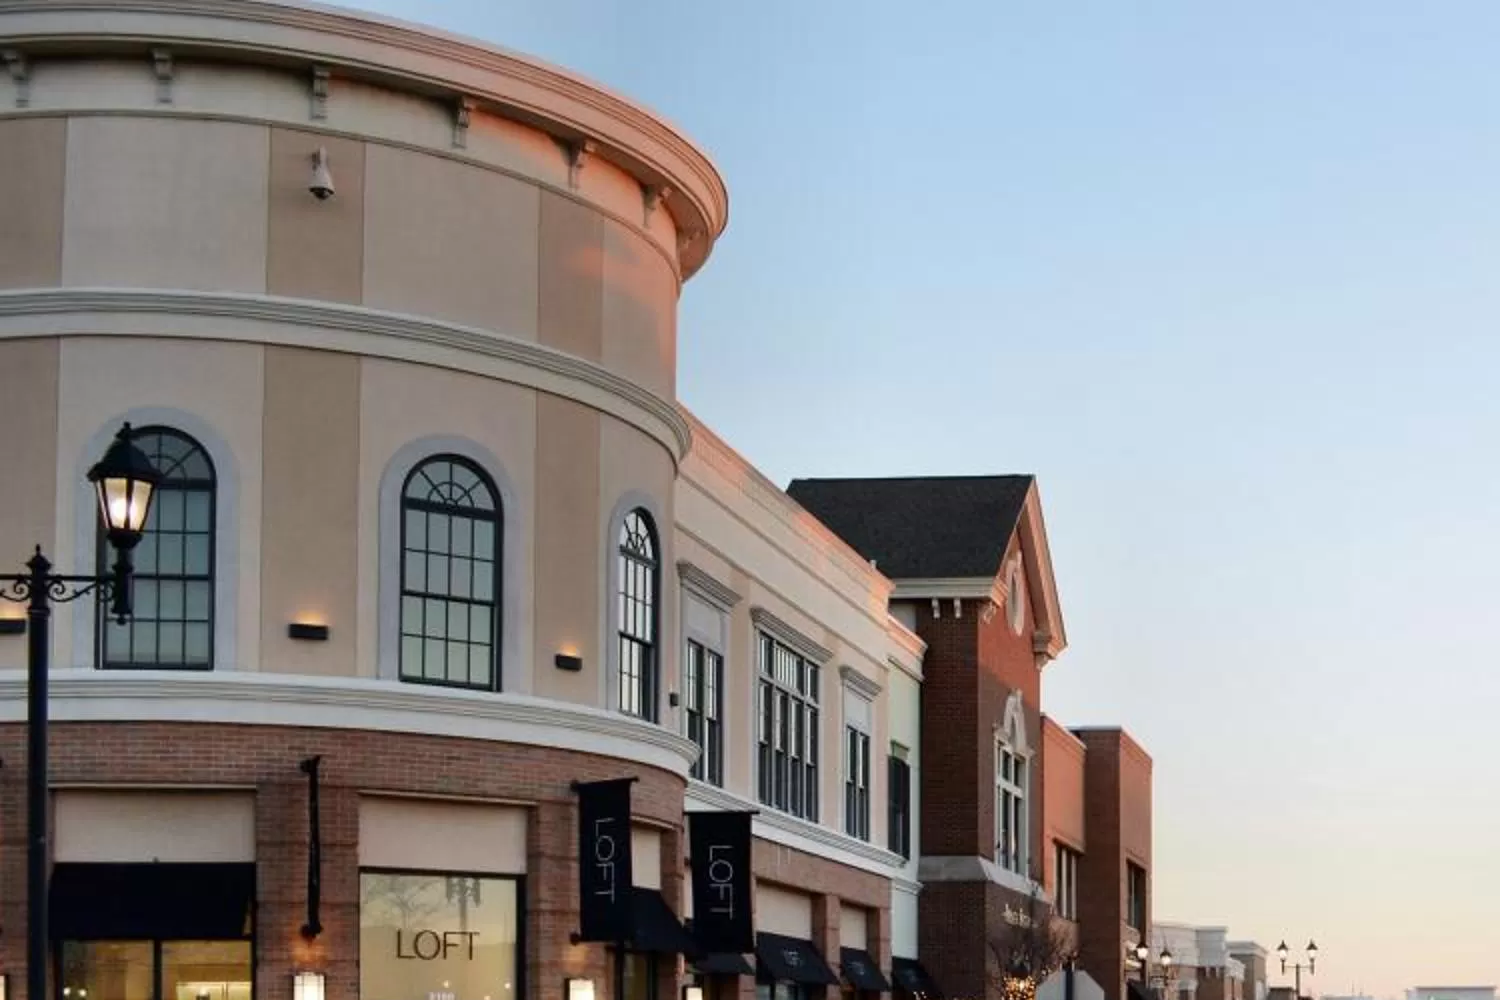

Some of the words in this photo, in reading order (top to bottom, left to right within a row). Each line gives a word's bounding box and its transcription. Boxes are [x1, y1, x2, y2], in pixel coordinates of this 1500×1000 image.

[594, 817, 616, 905] LOFT
[708, 845, 735, 921] LOFT
[396, 928, 480, 961] LOFT
